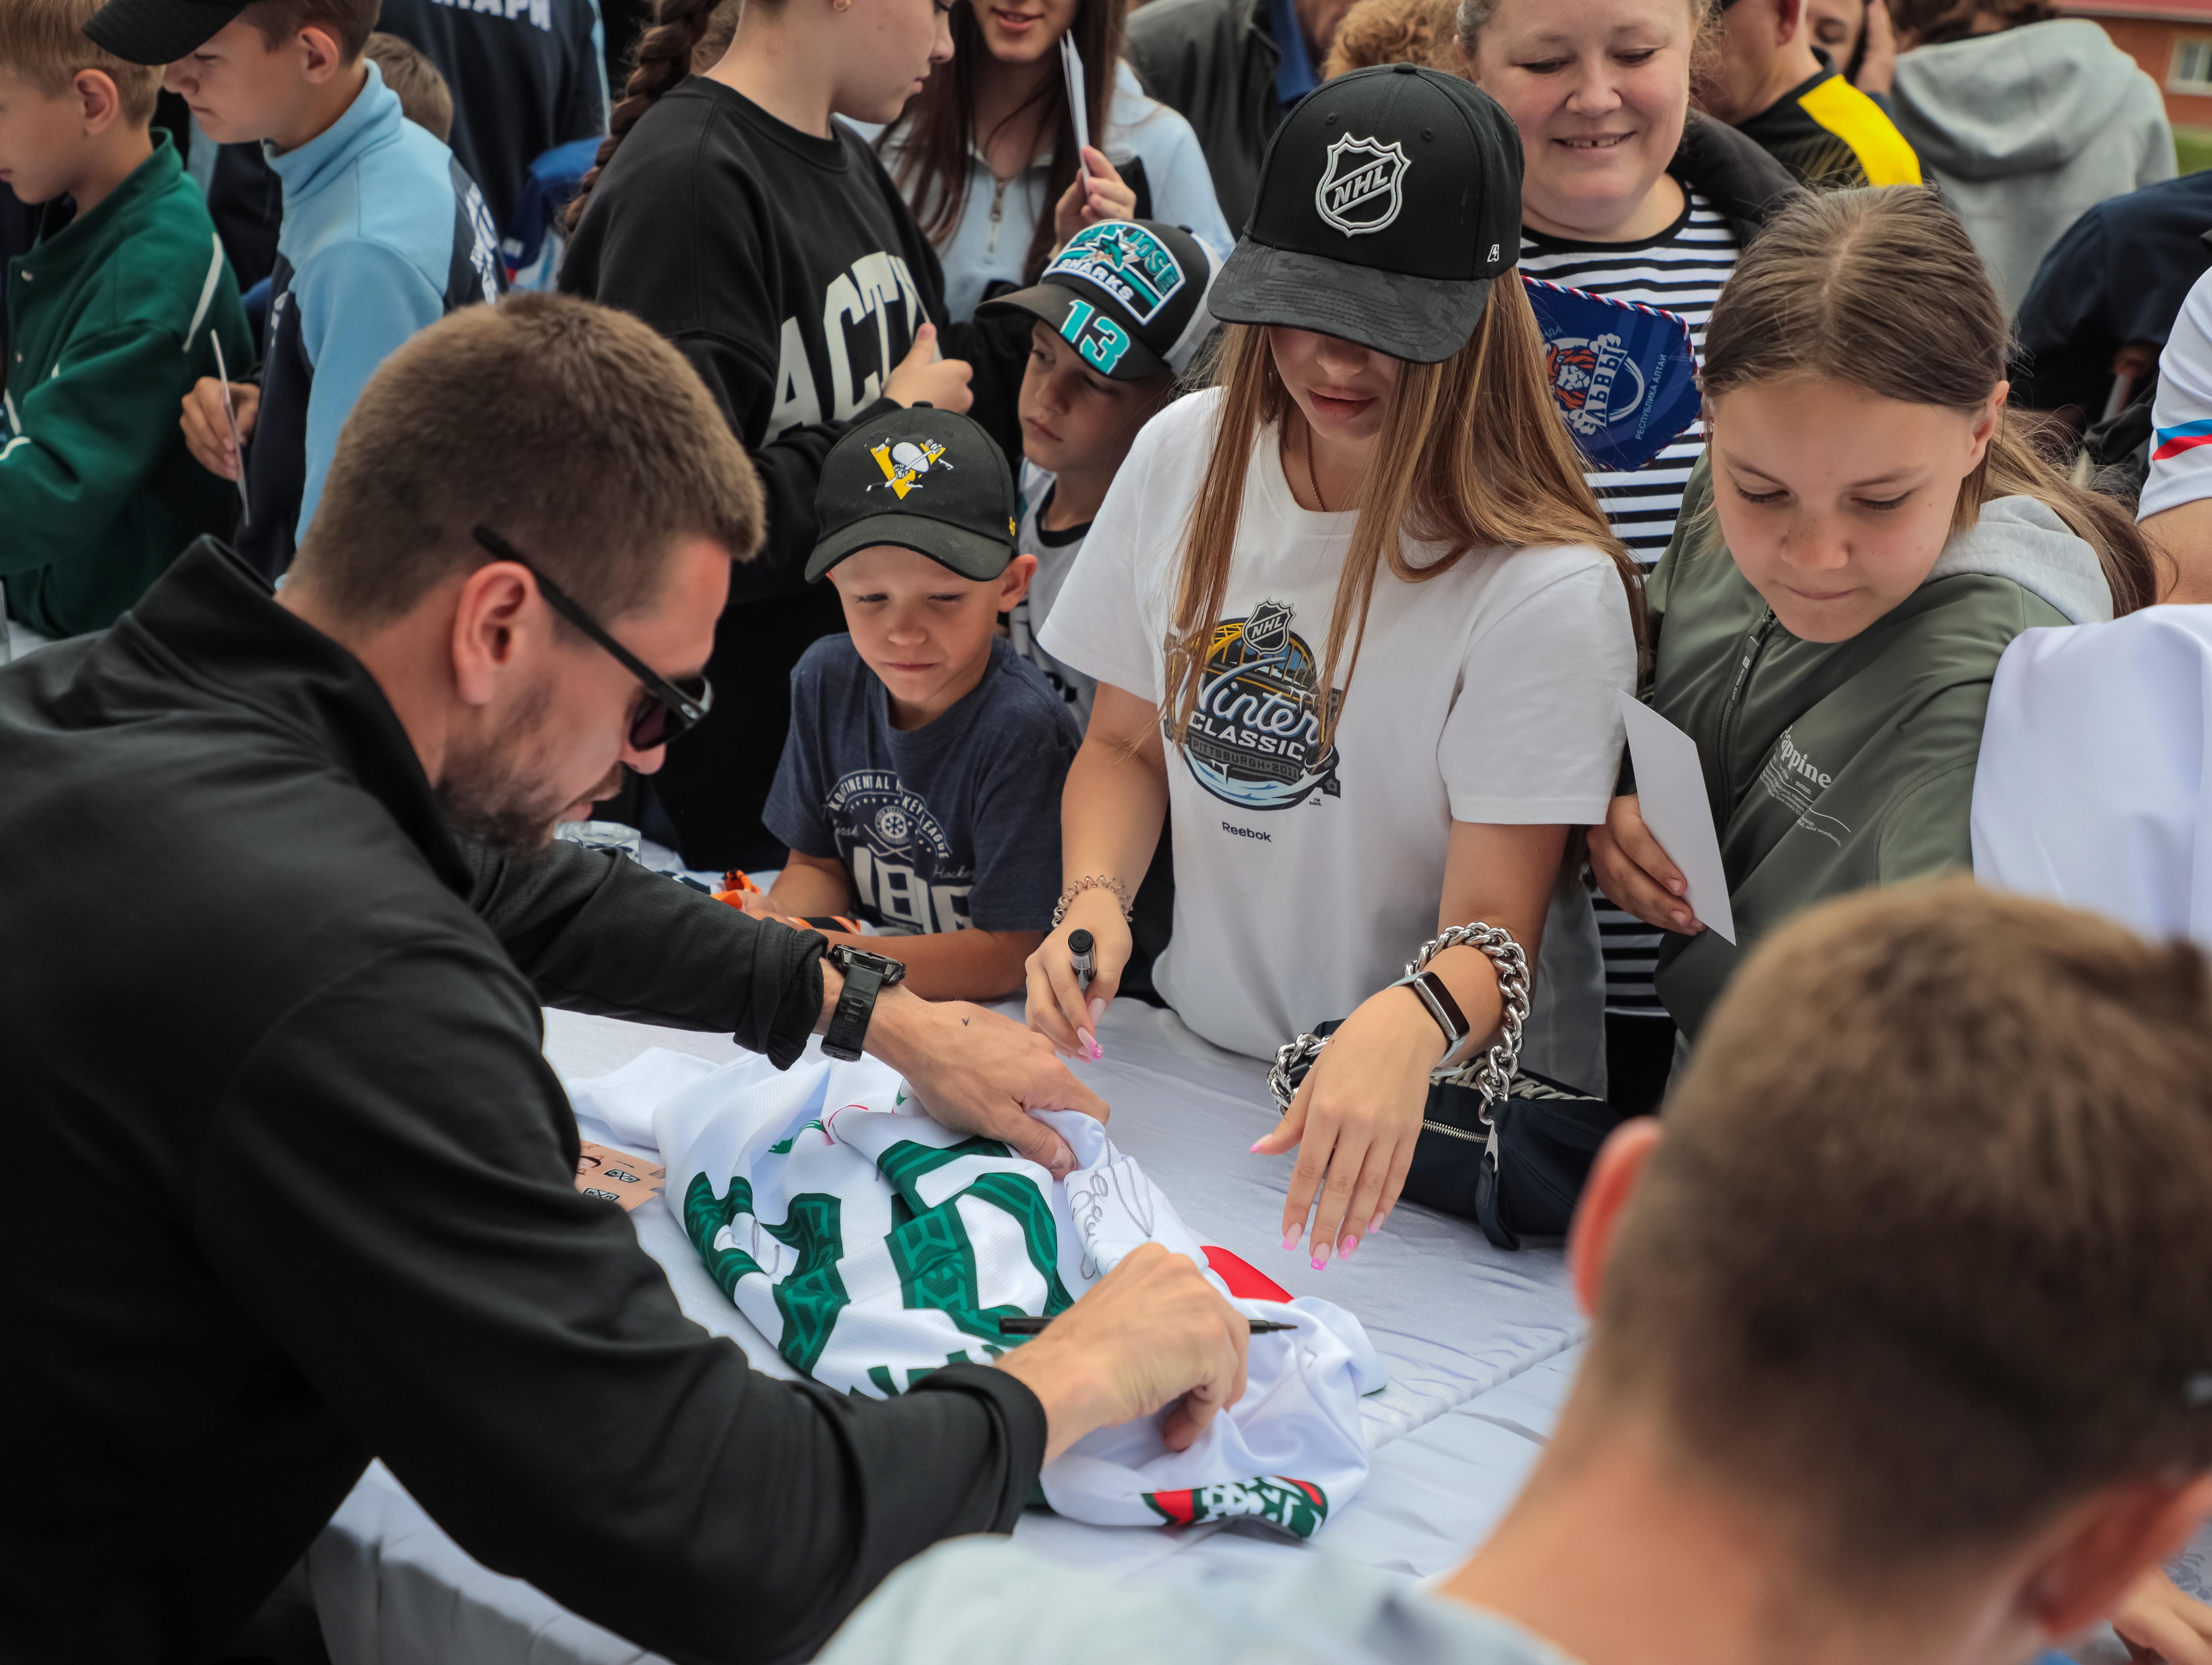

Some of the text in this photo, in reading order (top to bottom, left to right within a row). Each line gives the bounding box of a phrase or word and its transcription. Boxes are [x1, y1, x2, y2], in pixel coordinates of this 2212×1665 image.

[1333, 165, 1388, 209] NHL
[1058, 259, 1134, 301] SHARKS
[1060, 299, 1131, 374] 13
[1585, 345, 1625, 425] ЛЬВЫ
[1636, 385, 1658, 440] РЕСПУБЛИКА
[1252, 615, 1283, 637] NHL
[1736, 668, 1744, 686] GLORIA
[1189, 711, 1305, 761] CLASSIC
[1193, 738, 1297, 778] PITTSBURGH 2011
[1795, 781, 1811, 795] noun
[1222, 822, 1272, 842] Reebok
